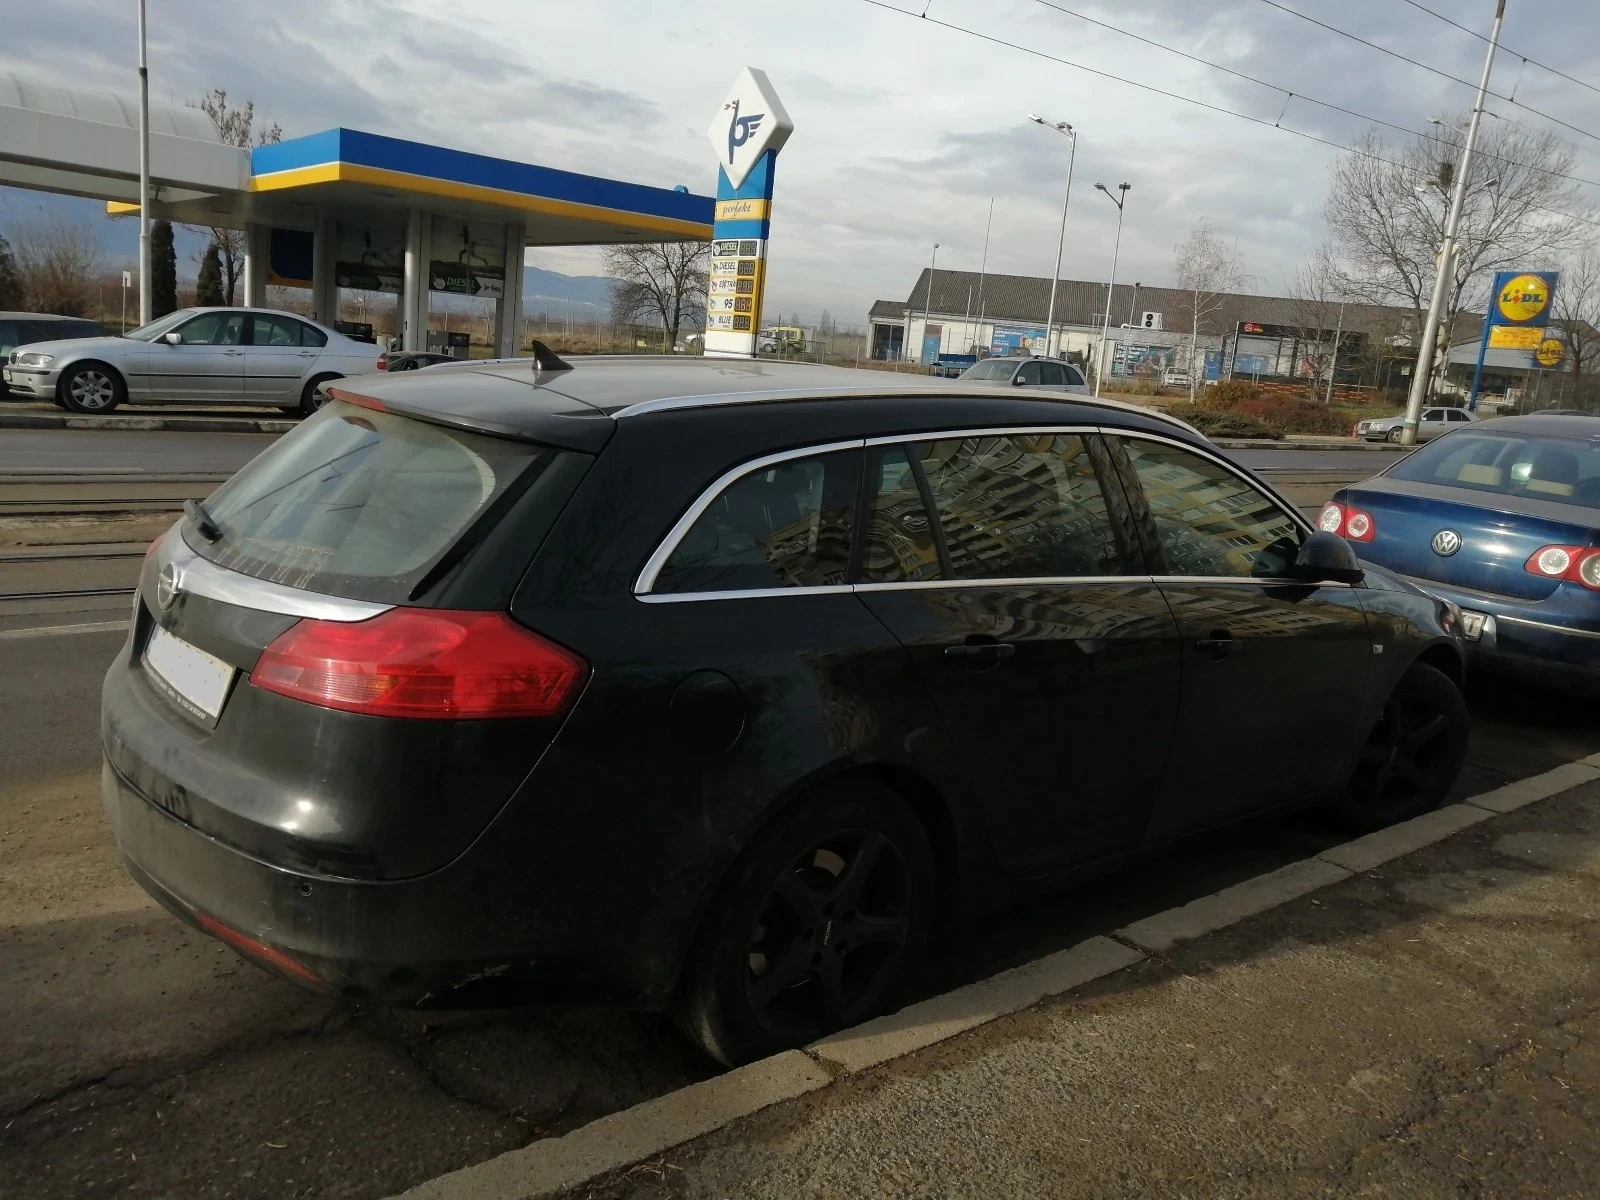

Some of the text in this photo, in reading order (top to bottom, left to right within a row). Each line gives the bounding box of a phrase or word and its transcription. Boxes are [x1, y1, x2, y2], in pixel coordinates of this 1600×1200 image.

[446, 276, 476, 289] DIESL
[1502, 288, 1544, 303] LIDL
[724, 298, 734, 309] 95
